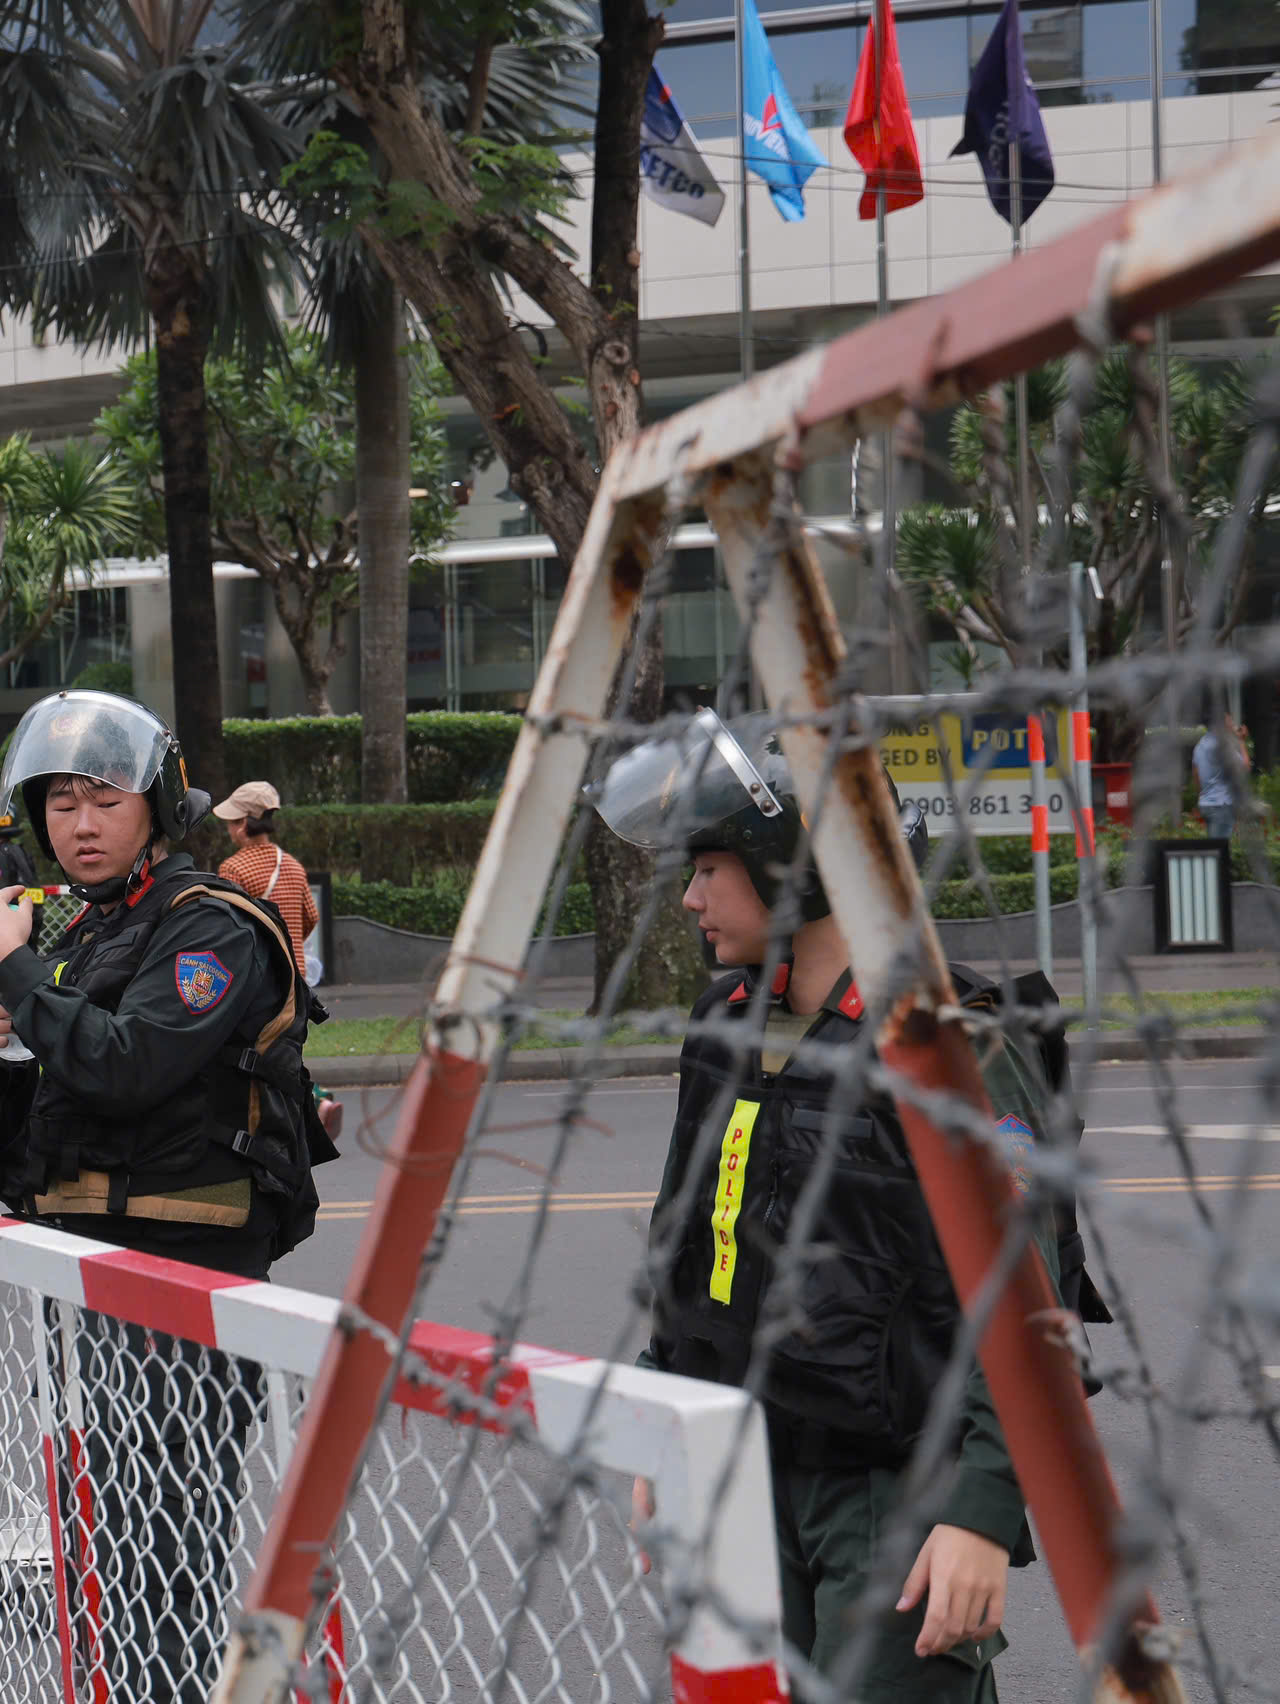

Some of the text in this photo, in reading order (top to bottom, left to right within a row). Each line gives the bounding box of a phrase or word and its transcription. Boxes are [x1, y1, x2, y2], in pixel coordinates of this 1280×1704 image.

[972, 728, 1029, 751] POT
[970, 793, 1010, 815] 861
[1018, 793, 1062, 814] 30
[719, 1127, 743, 1272] POLICE
